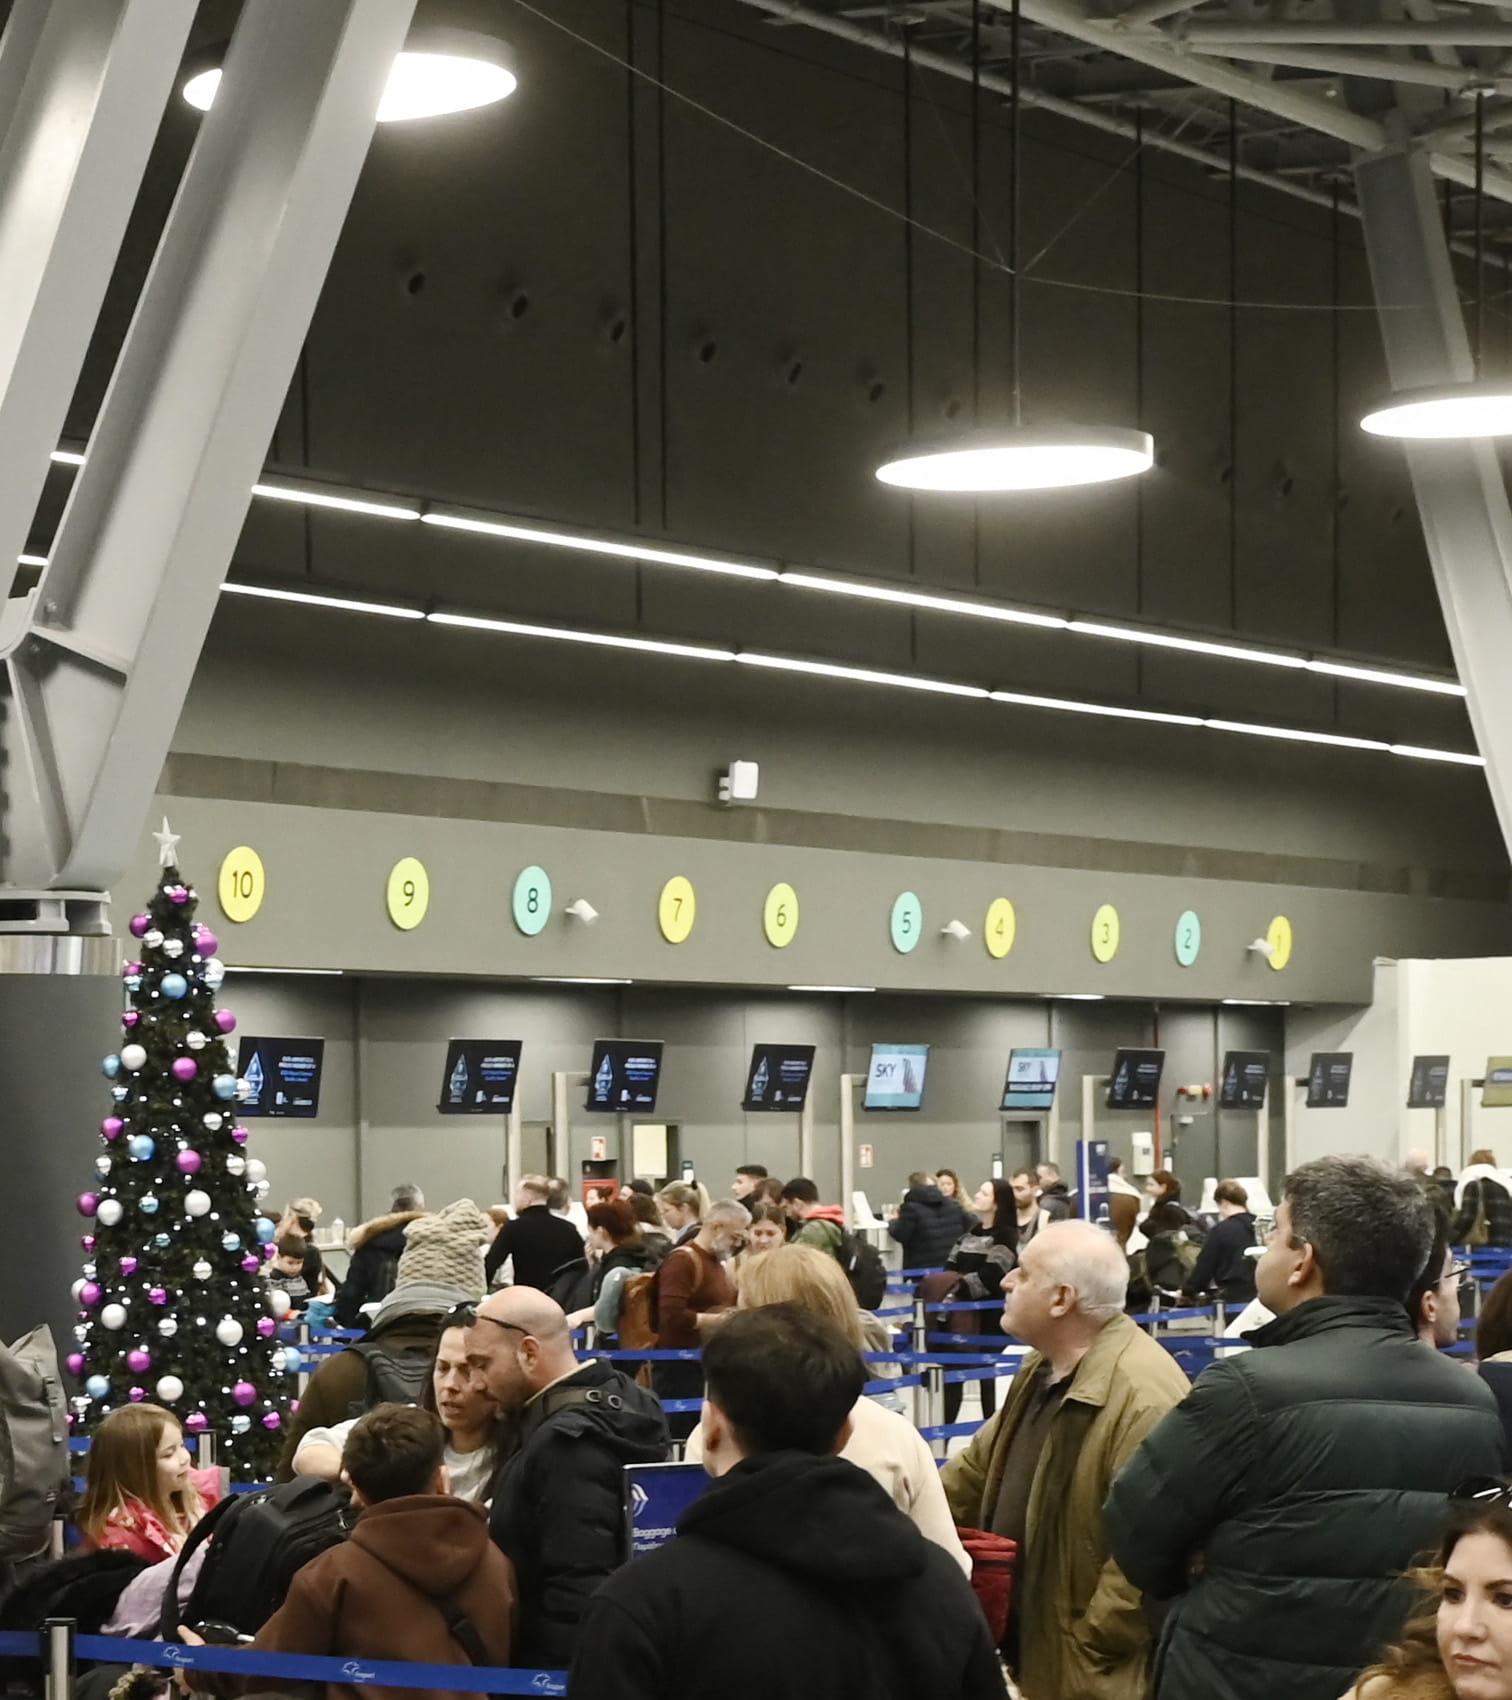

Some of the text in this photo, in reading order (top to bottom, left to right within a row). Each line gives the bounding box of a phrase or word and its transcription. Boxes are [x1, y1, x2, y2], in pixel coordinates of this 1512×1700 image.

[233, 872, 253, 899] 10
[403, 880, 415, 907] 9
[527, 887, 539, 914] 8
[672, 898, 683, 922] 7
[777, 904, 787, 928] 6
[901, 911, 912, 934] 5
[995, 918, 1005, 938] 4
[1102, 923, 1111, 944] 3
[1183, 929, 1193, 950] 2
[875, 1063, 897, 1078] SKY
[632, 1527, 672, 1539] Baggage
